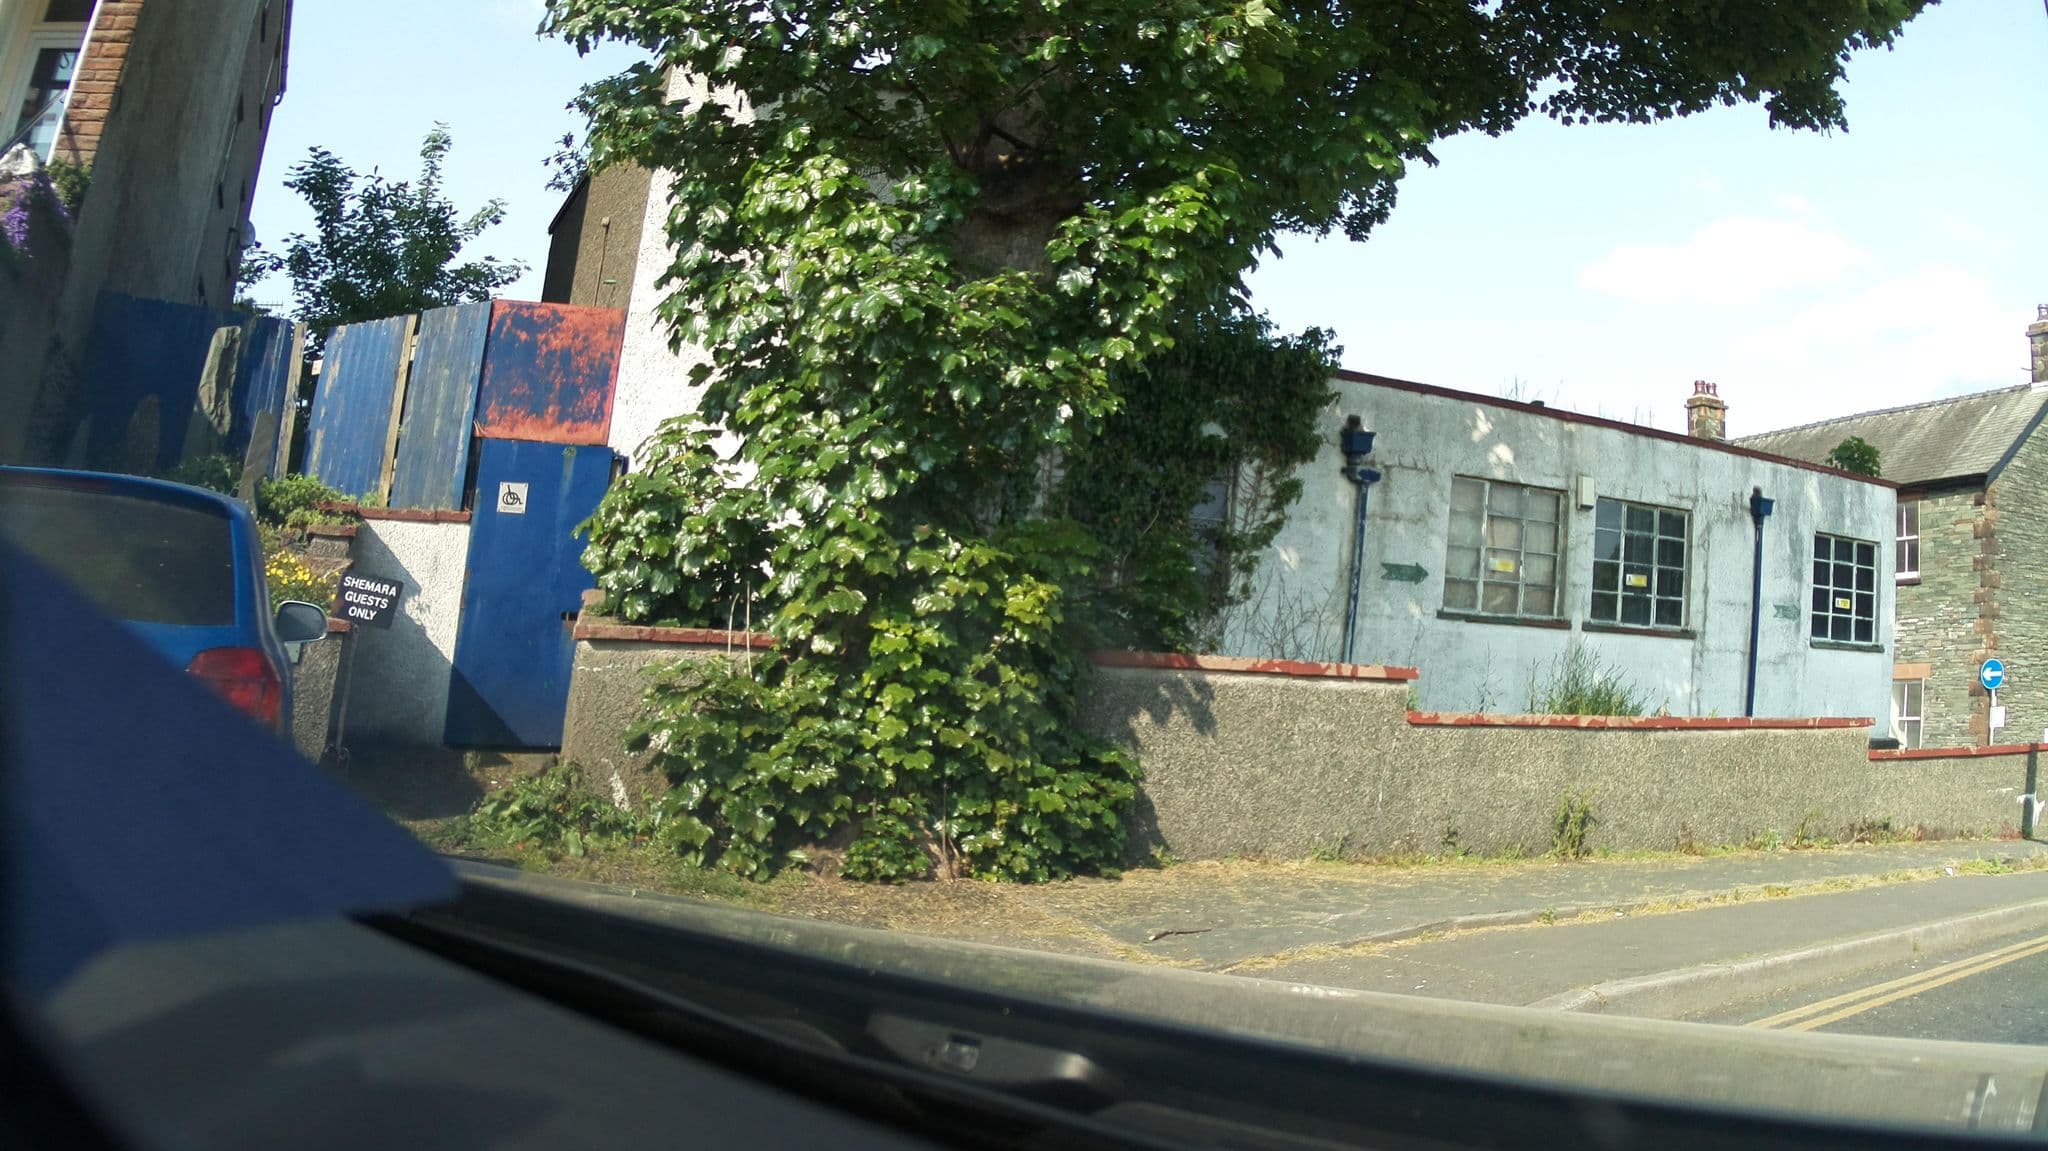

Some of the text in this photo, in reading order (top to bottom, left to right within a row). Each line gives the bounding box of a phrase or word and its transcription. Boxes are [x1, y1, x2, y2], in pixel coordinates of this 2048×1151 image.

[343, 576, 397, 597] SHEMARA
[344, 590, 389, 609] GUESTS
[348, 605, 377, 620] ONLY
